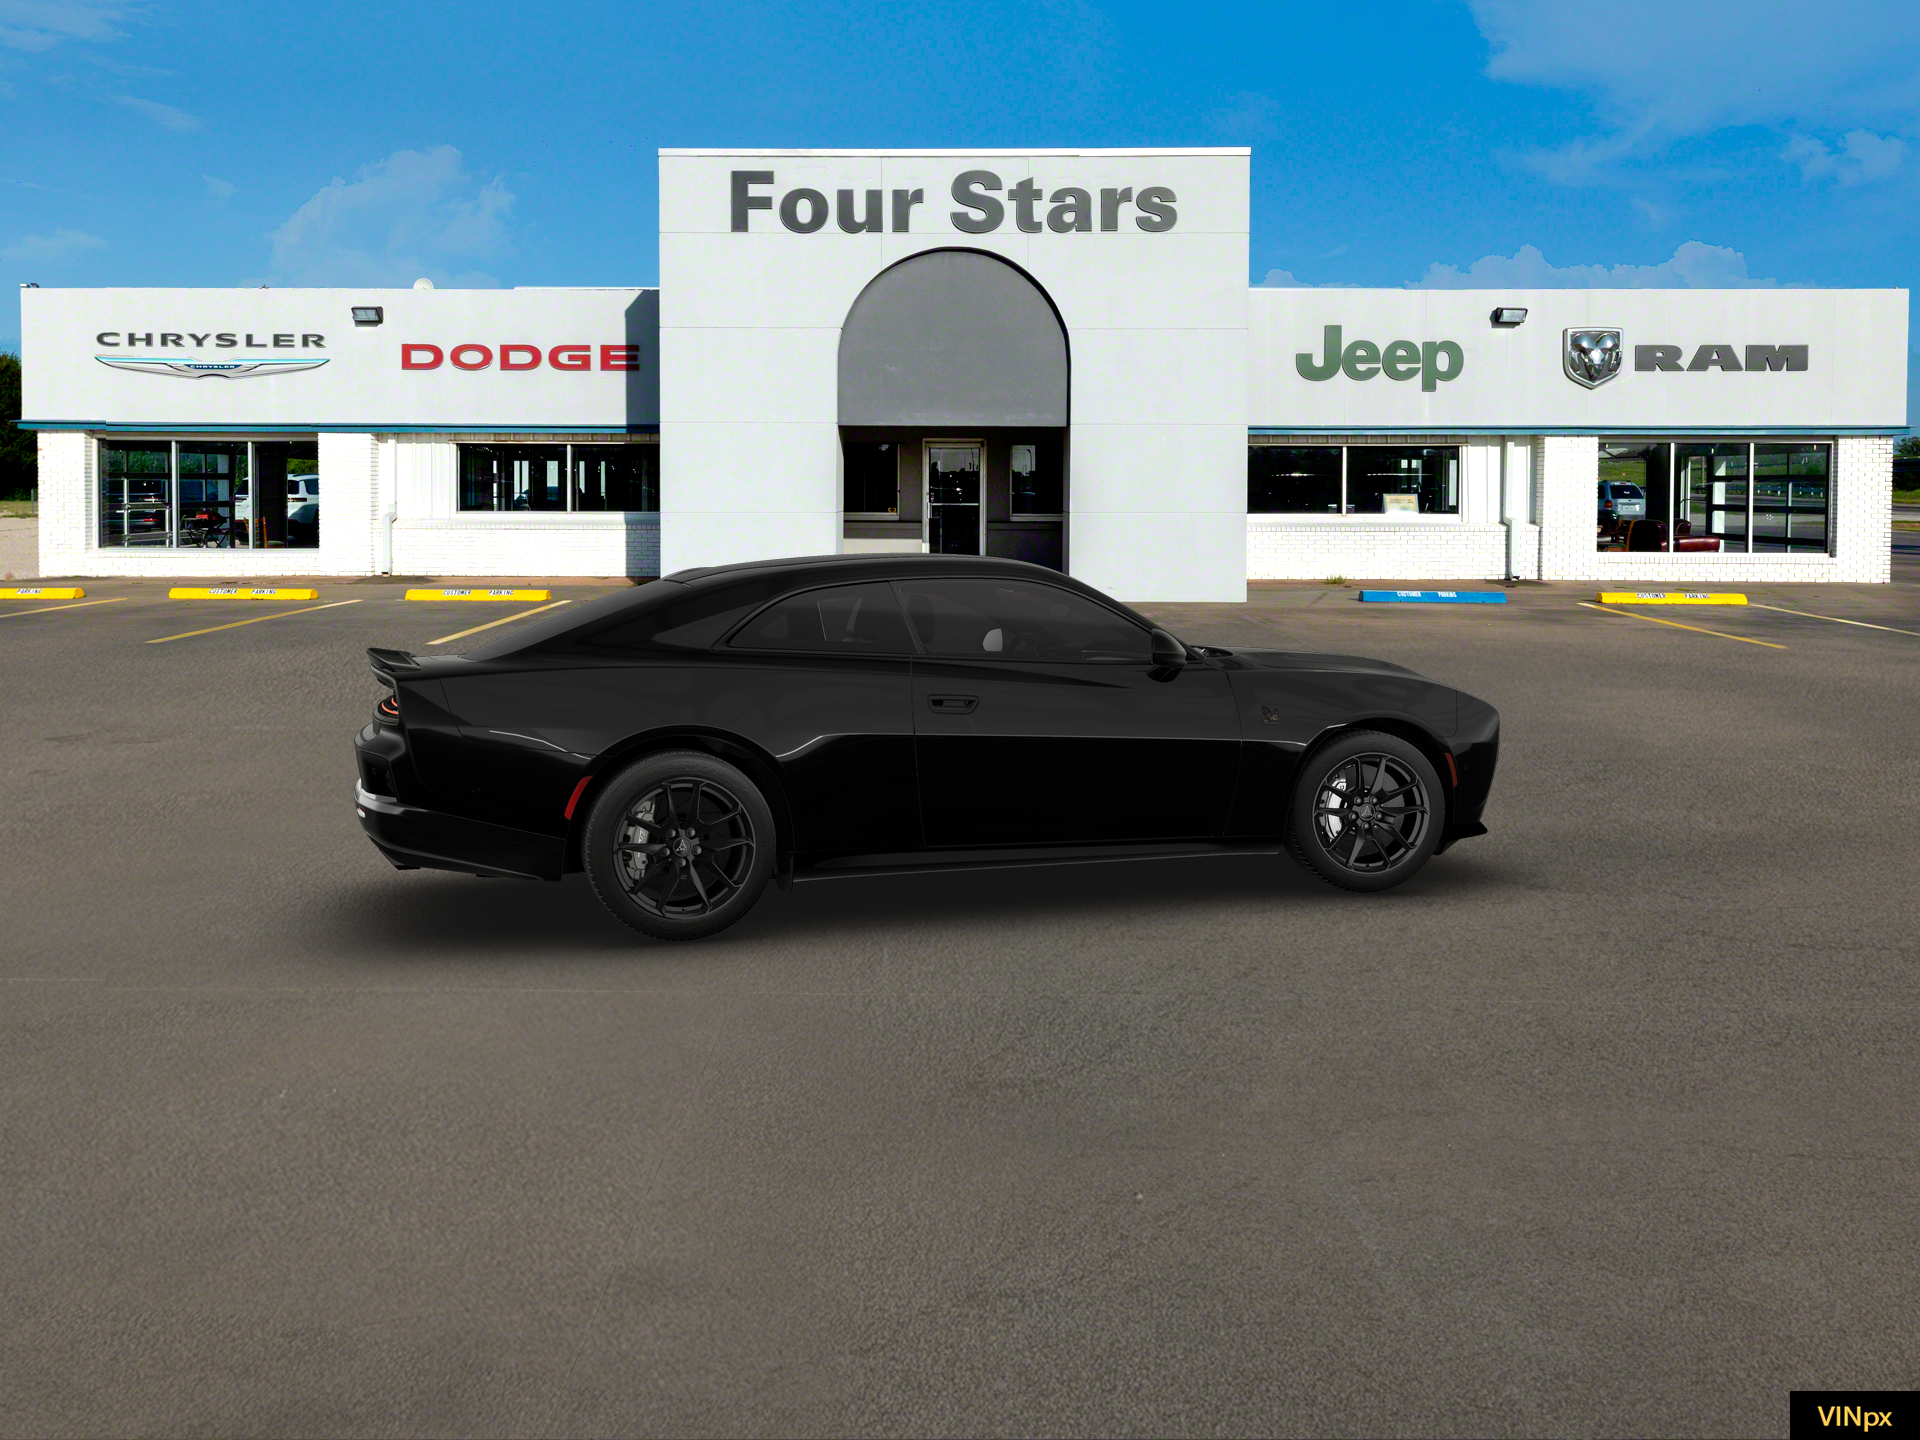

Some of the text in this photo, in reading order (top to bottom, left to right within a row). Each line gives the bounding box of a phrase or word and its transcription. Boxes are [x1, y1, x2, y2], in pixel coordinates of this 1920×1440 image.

[730, 169, 1178, 233] Four Stars
[96, 332, 327, 348] CHRYSLER
[401, 343, 640, 371] DODGE
[1295, 324, 1465, 392] Jeep
[1634, 344, 1809, 371] RAM
